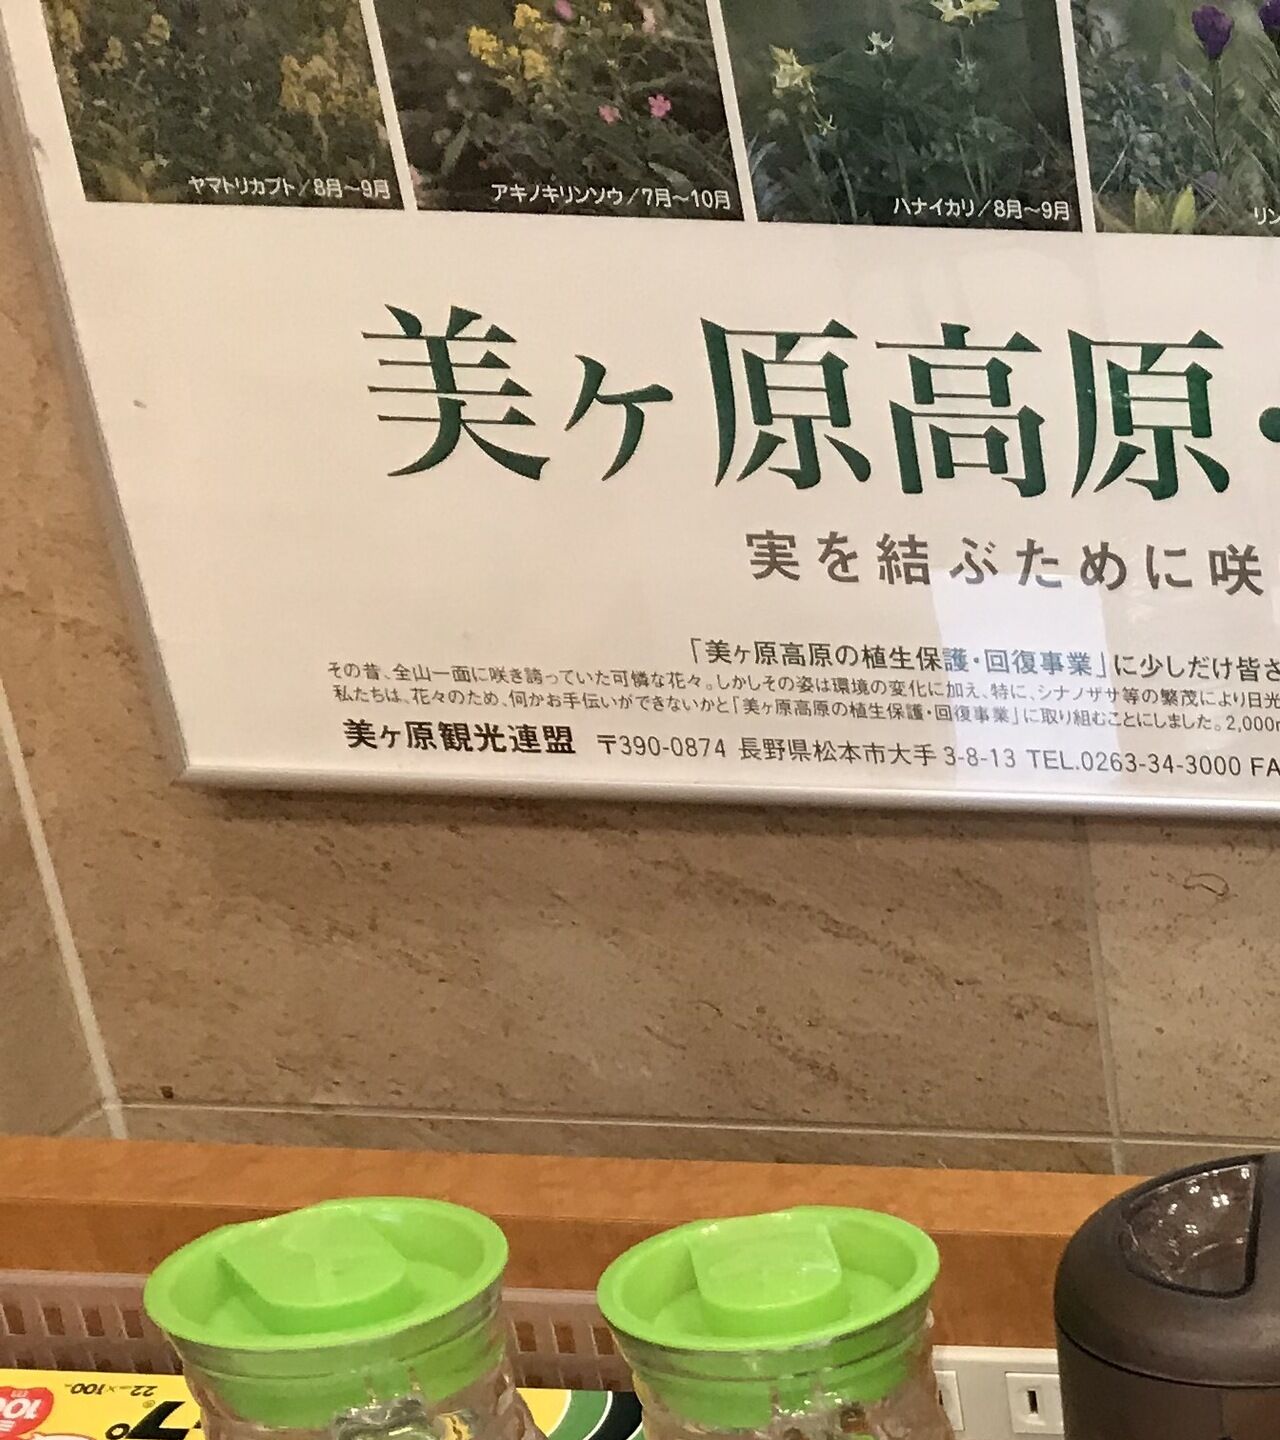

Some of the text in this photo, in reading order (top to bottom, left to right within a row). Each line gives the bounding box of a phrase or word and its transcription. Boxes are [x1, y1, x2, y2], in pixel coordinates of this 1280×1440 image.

[342, 718, 577, 756] 美ヶ原観光連盟
[1026, 749, 1242, 778] TEL.0263-34-3000
